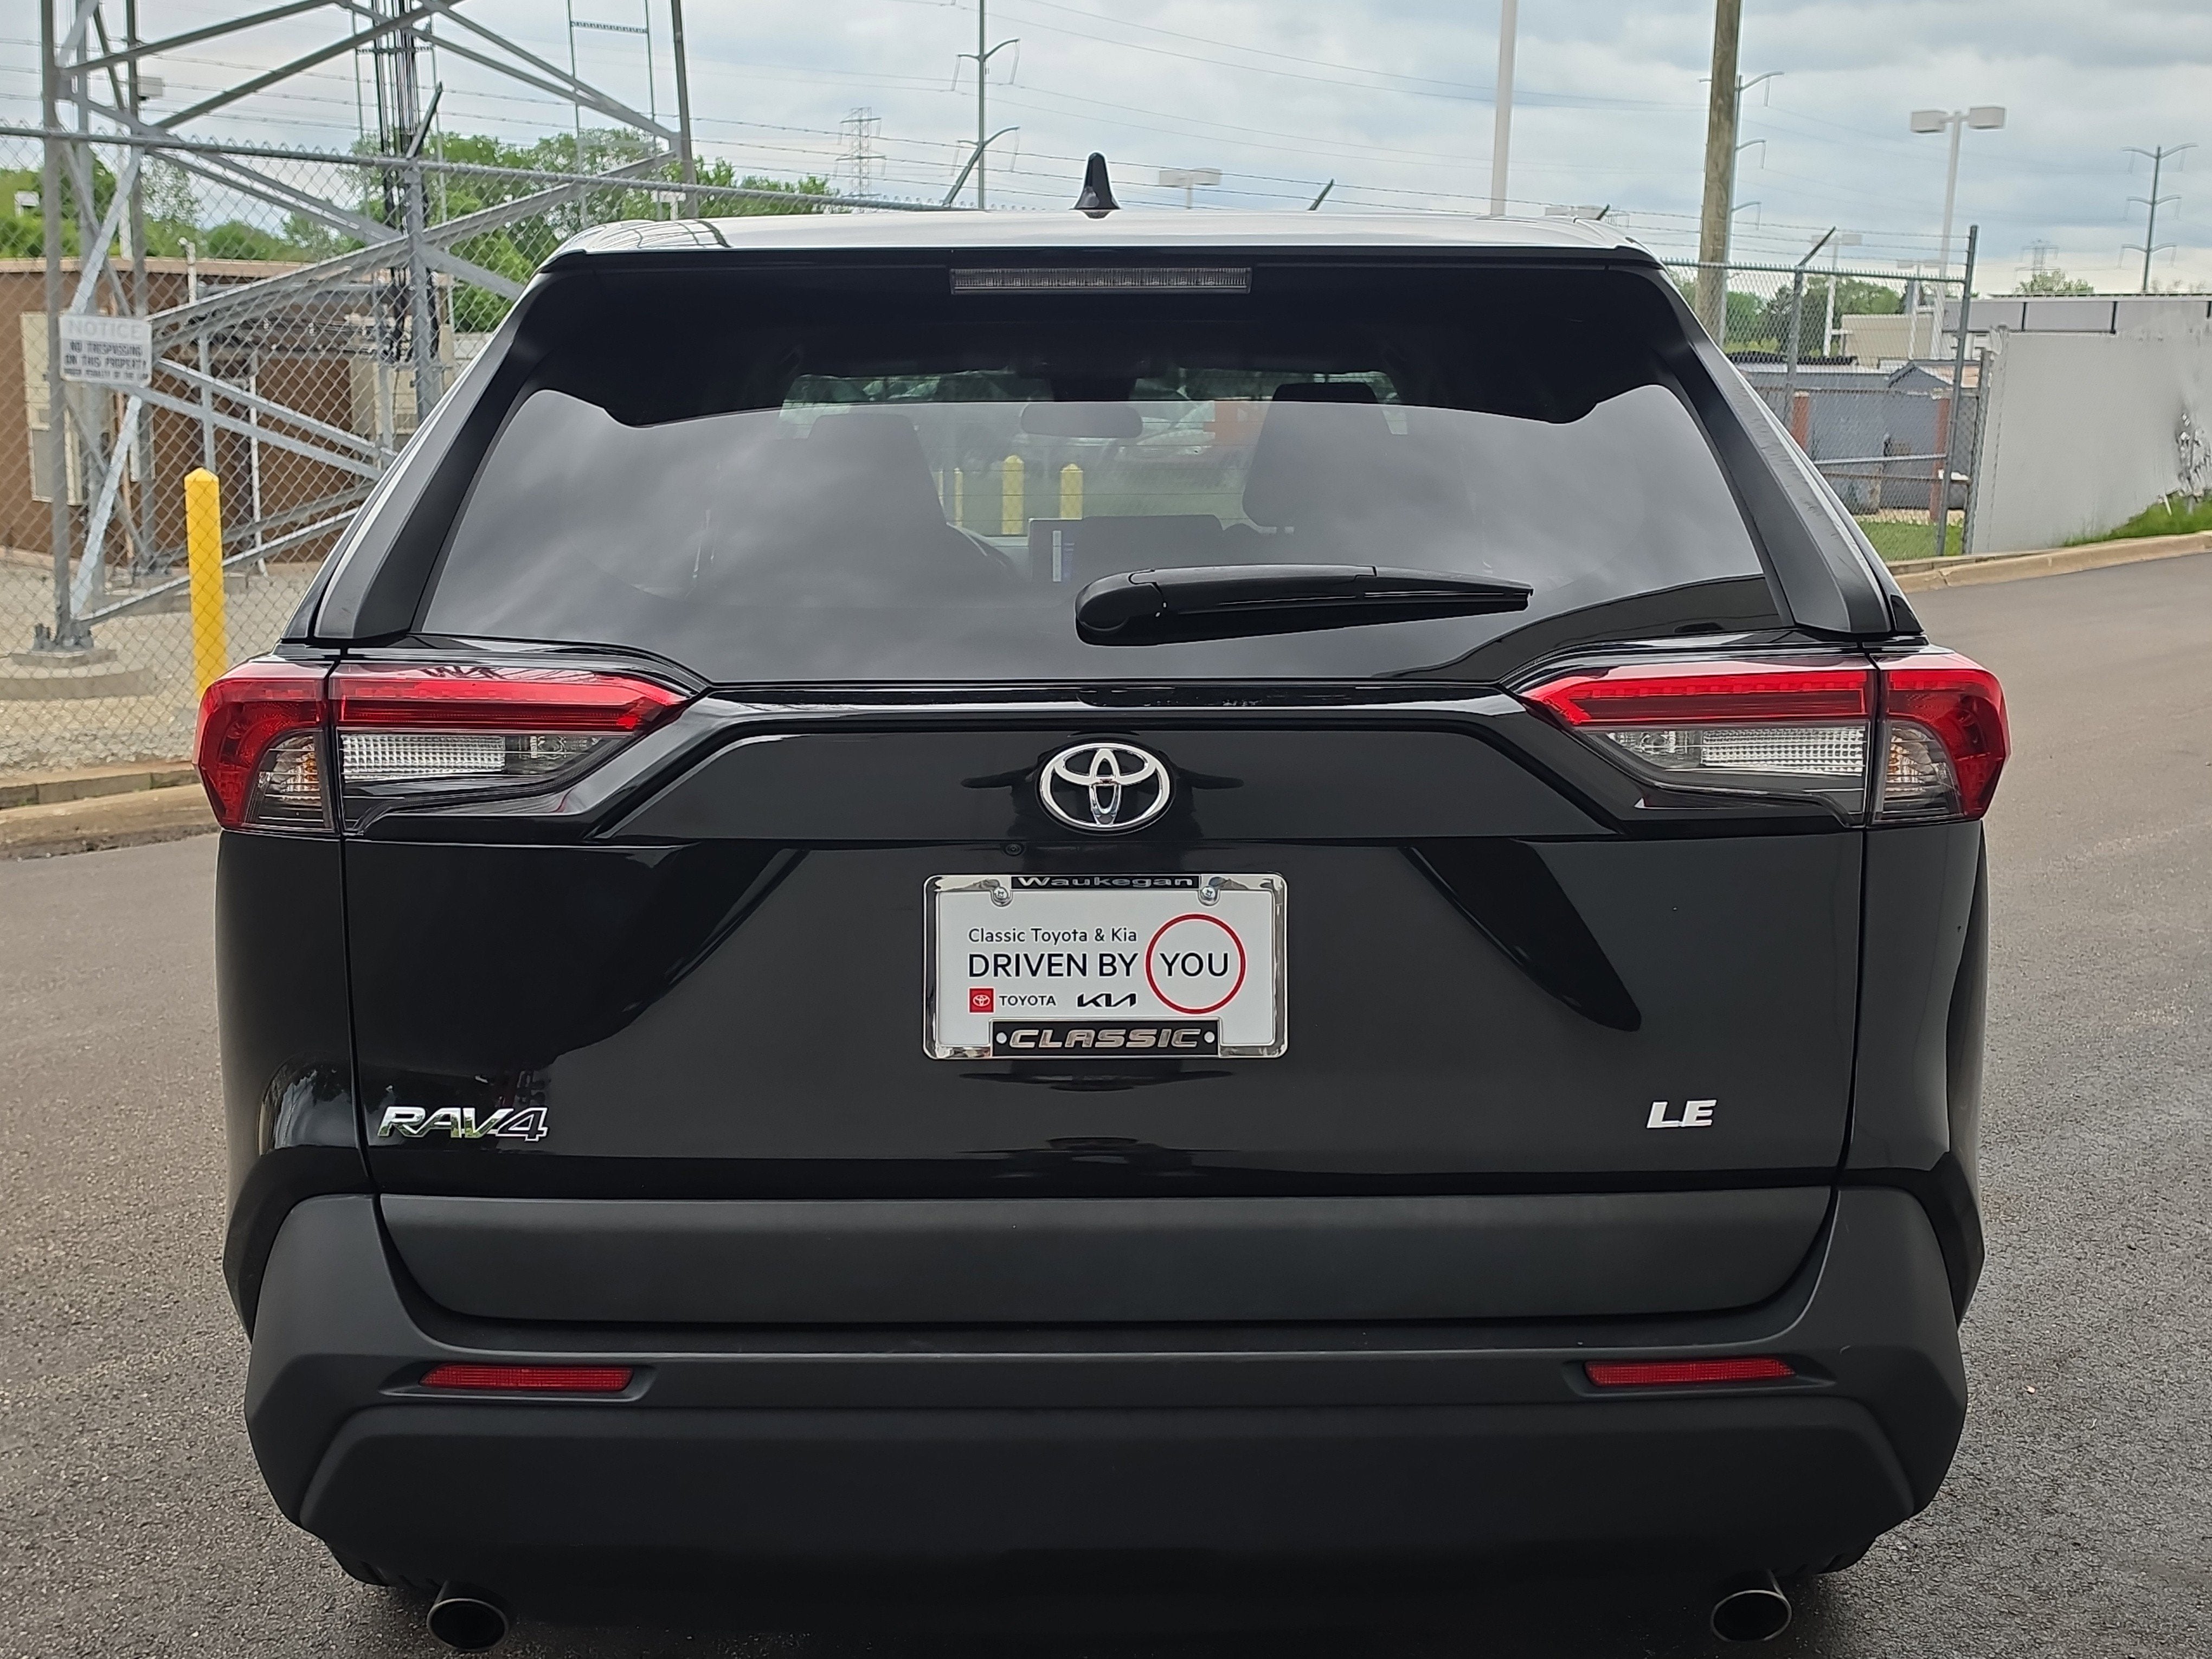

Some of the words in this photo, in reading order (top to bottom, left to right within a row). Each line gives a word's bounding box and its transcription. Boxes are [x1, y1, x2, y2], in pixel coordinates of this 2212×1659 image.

[68, 320, 143, 339] NOTICE
[70, 340, 82, 353] NO
[1018, 876, 1193, 888] Waukegan
[968, 928, 1025, 942] Classic
[1031, 928, 1088, 945] Toyota
[1094, 929, 1105, 942] &
[1111, 928, 1137, 942] Kia
[969, 953, 1087, 976] DRIVEN
[1098, 953, 1138, 976] BY
[1159, 953, 1229, 976] YOU
[999, 995, 1056, 1006] TOYOTA
[1009, 1028, 1201, 1049] CLASSIC
[1646, 1099, 1717, 1128] LE
[377, 1106, 548, 1142] RAV4
